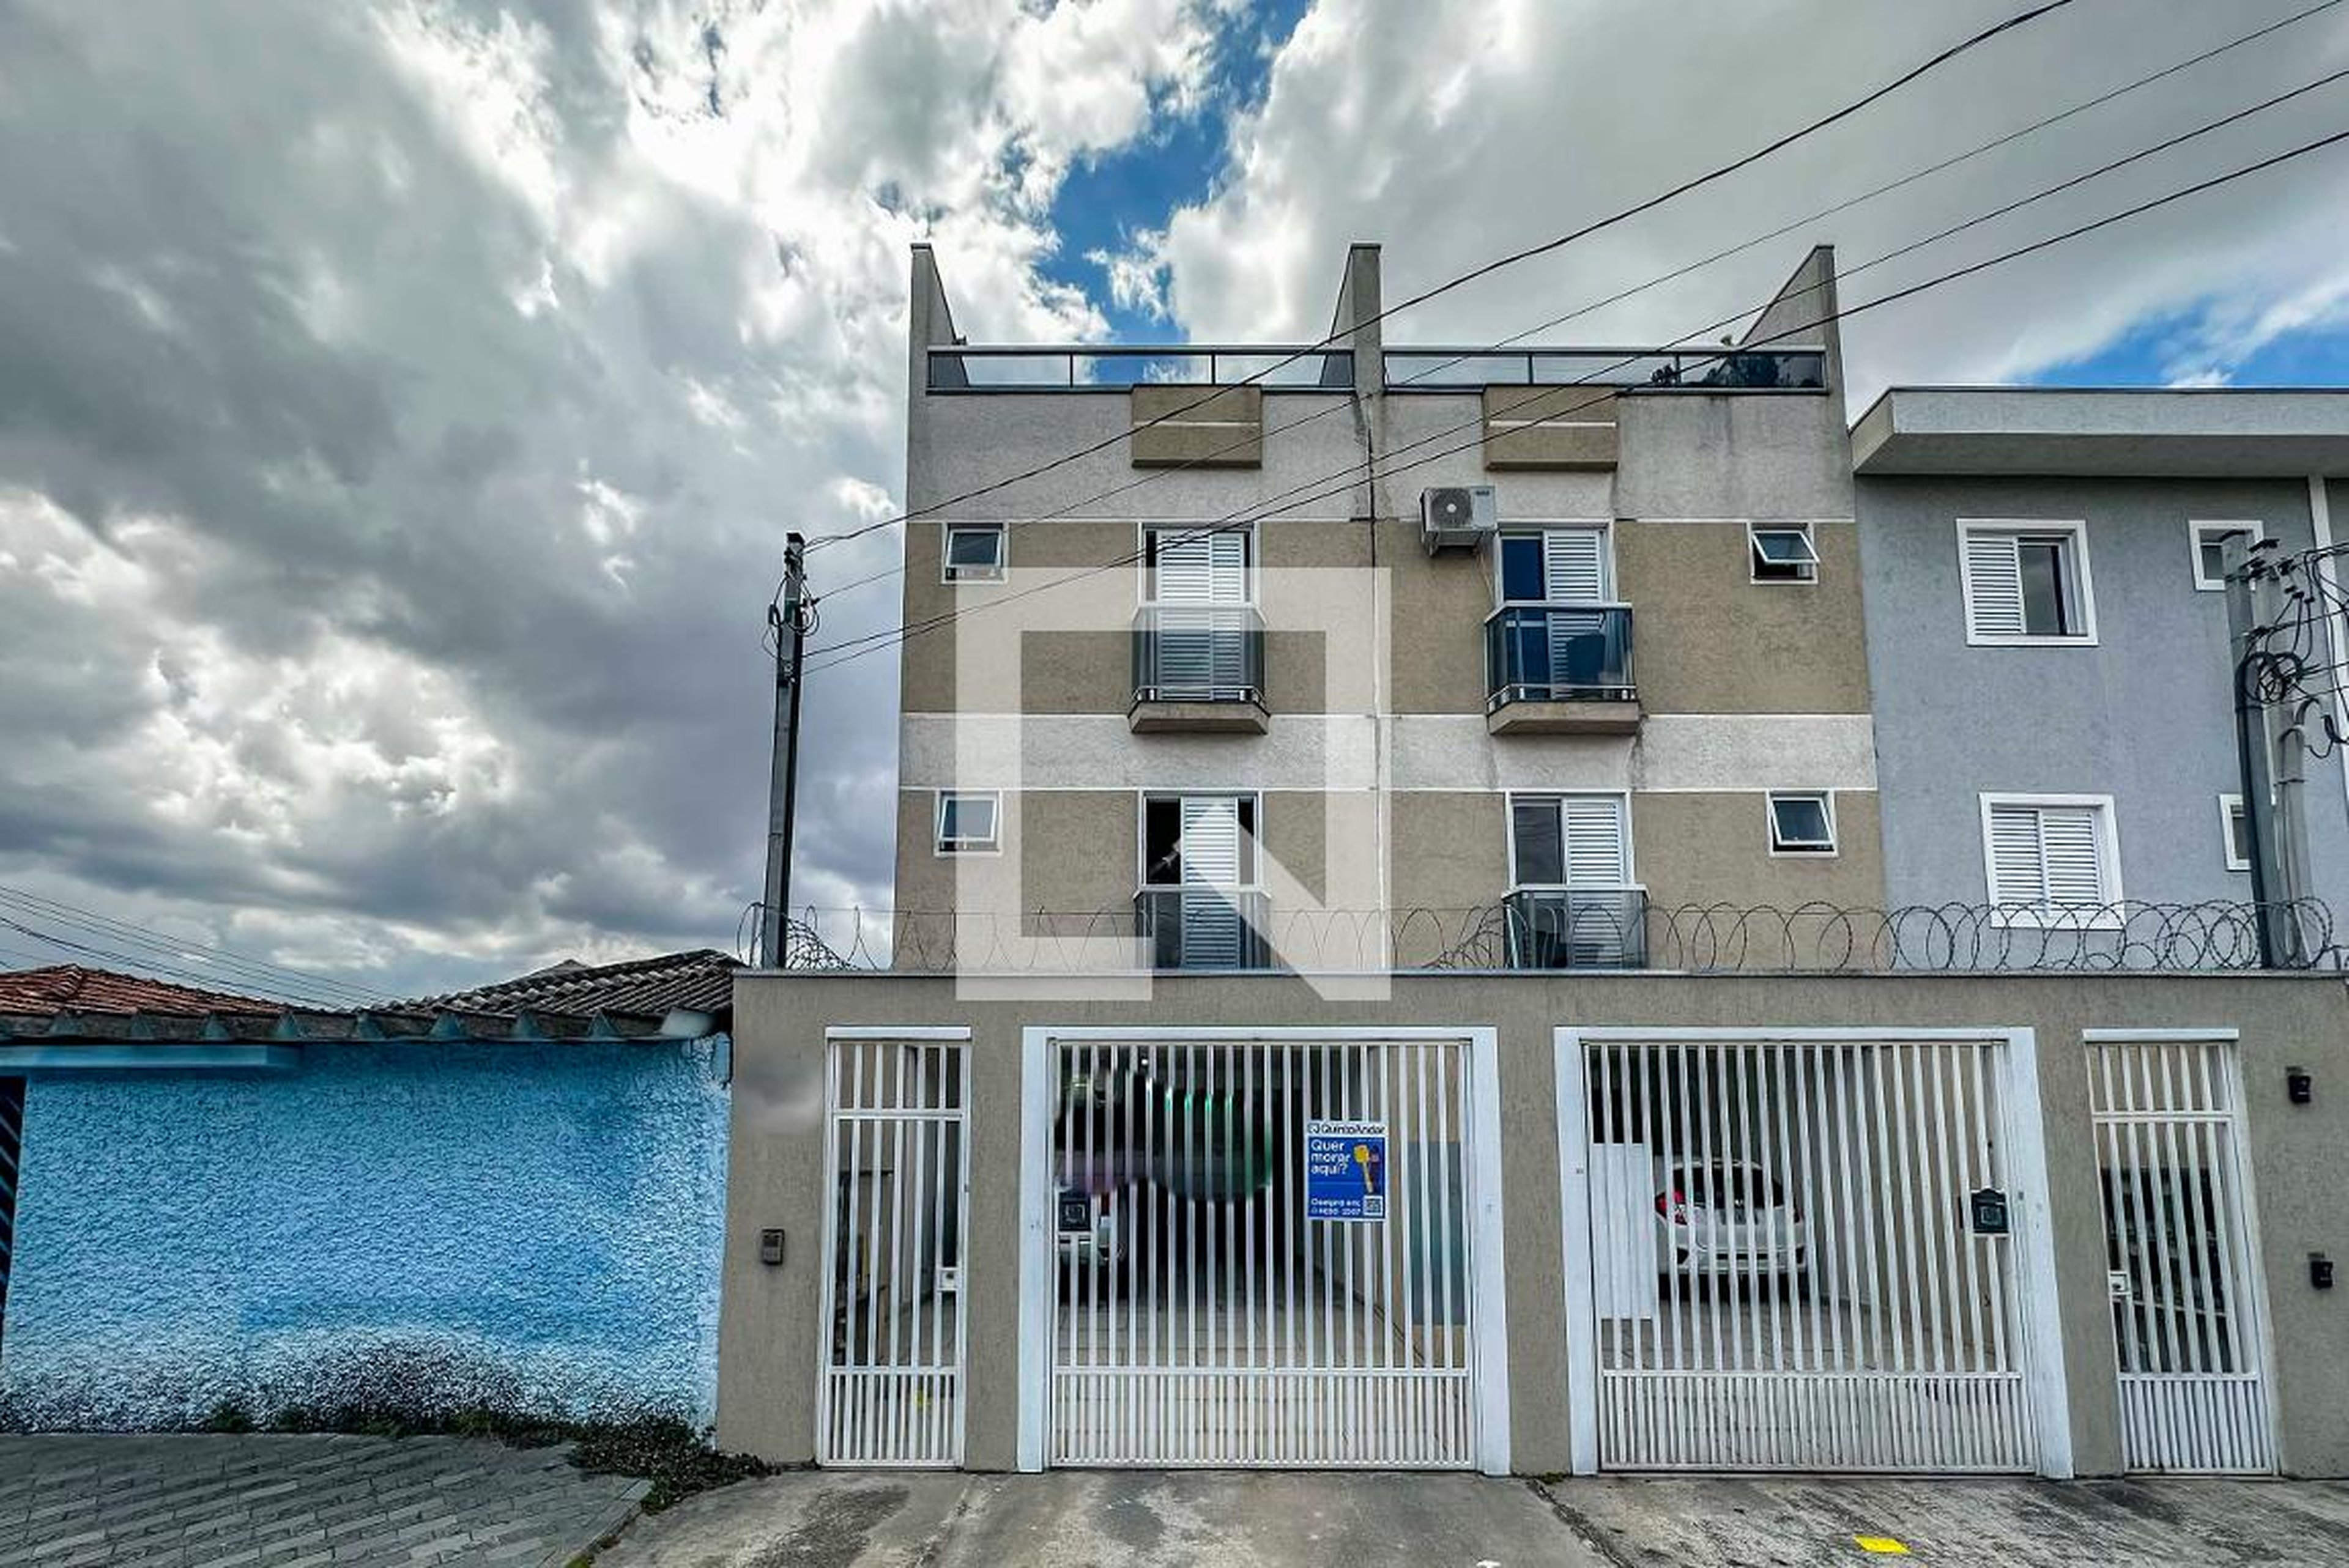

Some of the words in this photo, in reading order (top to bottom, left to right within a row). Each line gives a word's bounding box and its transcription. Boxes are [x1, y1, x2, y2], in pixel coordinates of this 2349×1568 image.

[1321, 1123, 1385, 1134] QuintoAndar
[1311, 1138, 1345, 1152] Quer
[1311, 1153, 1351, 1163] morar
[1311, 1161, 1348, 1177] aqui?
